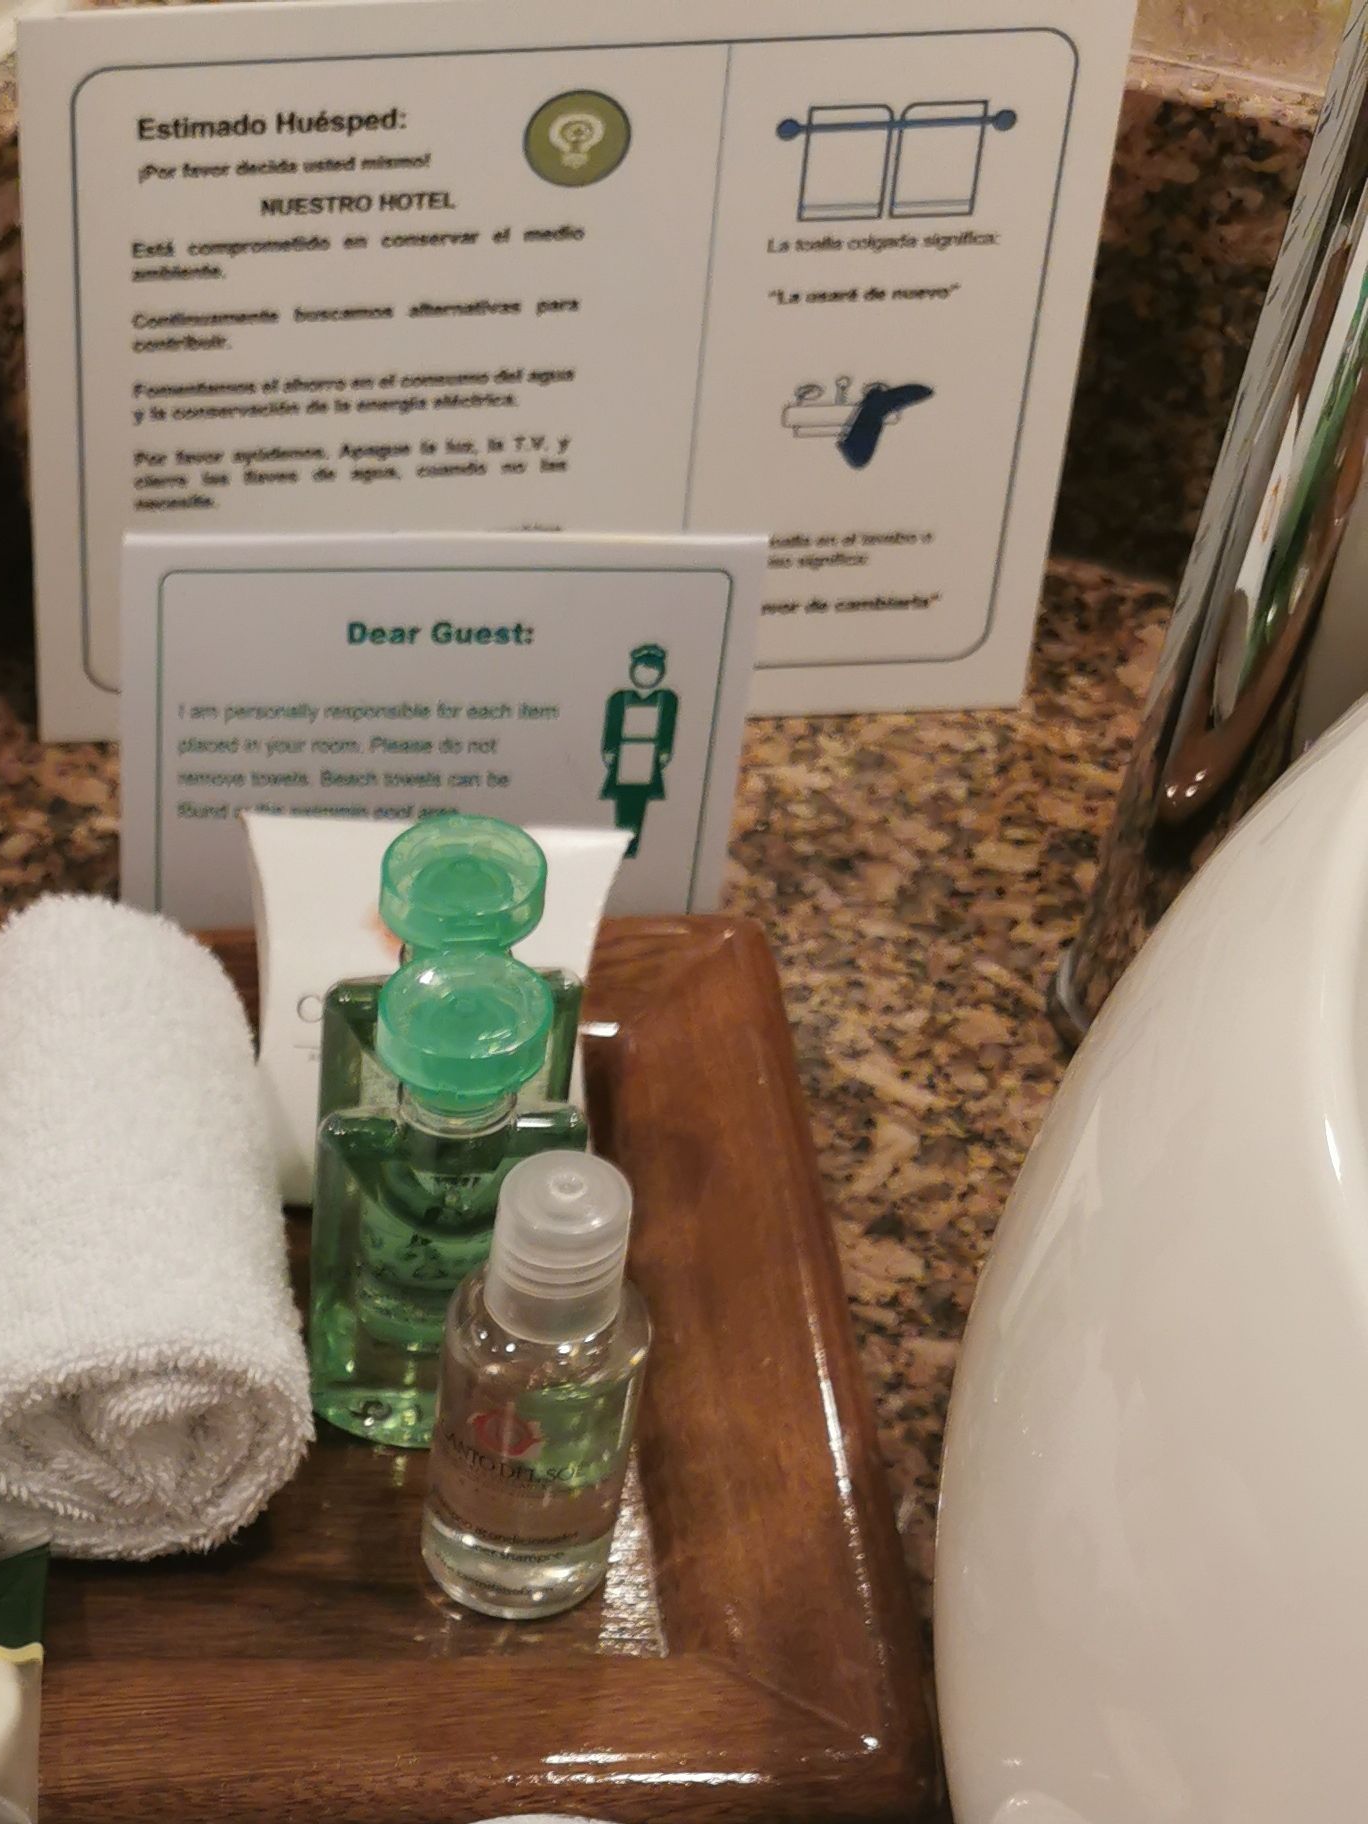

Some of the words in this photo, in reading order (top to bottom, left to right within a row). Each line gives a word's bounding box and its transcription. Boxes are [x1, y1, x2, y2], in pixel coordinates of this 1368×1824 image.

[137, 114, 266, 140] Estimado
[275, 107, 408, 137] Huésped:
[181, 161, 231, 179] favor
[235, 157, 298, 178] decida
[302, 155, 356, 174] usted
[361, 152, 432, 172] mismo!
[260, 194, 374, 217] NUESTRO
[378, 190, 457, 212] HOTEL
[187, 234, 331, 259] comprometido
[343, 235, 369, 250] en
[380, 230, 481, 250] conservar
[493, 226, 512, 244] el
[523, 223, 587, 243] medio
[766, 238, 791, 253] La
[536, 298, 580, 318] para
[347, 621, 421, 645] Dear
[430, 621, 535, 646] Guest:
[189, 705, 218, 720] am
[224, 702, 321, 725] personally
[324, 703, 431, 723] responsible
[436, 702, 463, 719] for
[466, 702, 512, 719] each
[517, 703, 561, 720] item
[177, 737, 239, 758] placed
[265, 738, 307, 758] your
[368, 736, 434, 754] Please
[438, 737, 463, 754] do
[467, 737, 498, 754] not
[177, 771, 246, 788] remove
[319, 768, 378, 787] Beach
[383, 771, 441, 788] towels
[447, 773, 481, 788] can
[485, 770, 510, 787] be
